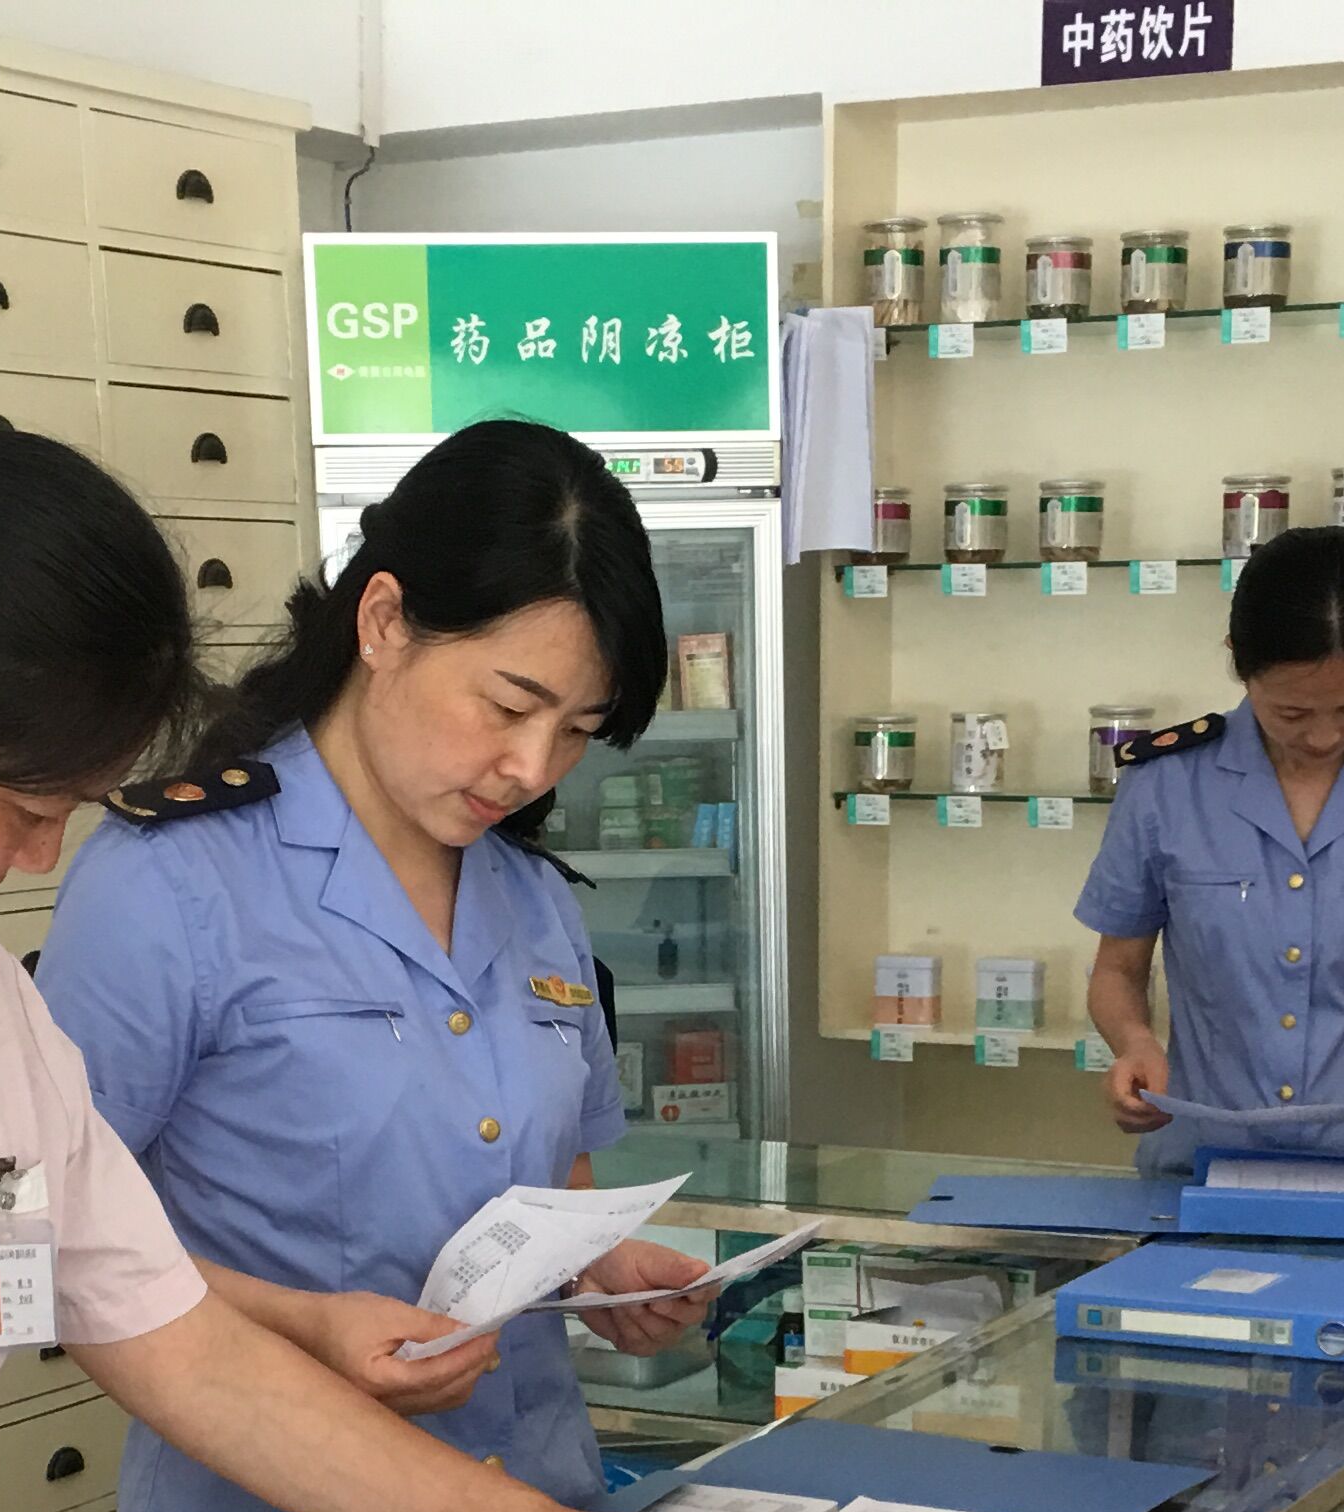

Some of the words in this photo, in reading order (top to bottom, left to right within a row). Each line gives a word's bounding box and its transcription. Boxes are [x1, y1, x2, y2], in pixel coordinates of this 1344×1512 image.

[1062, 2, 1213, 68] 中药饮片
[326, 301, 419, 340] GSP
[449, 312, 756, 365] 药品阴凉柜
